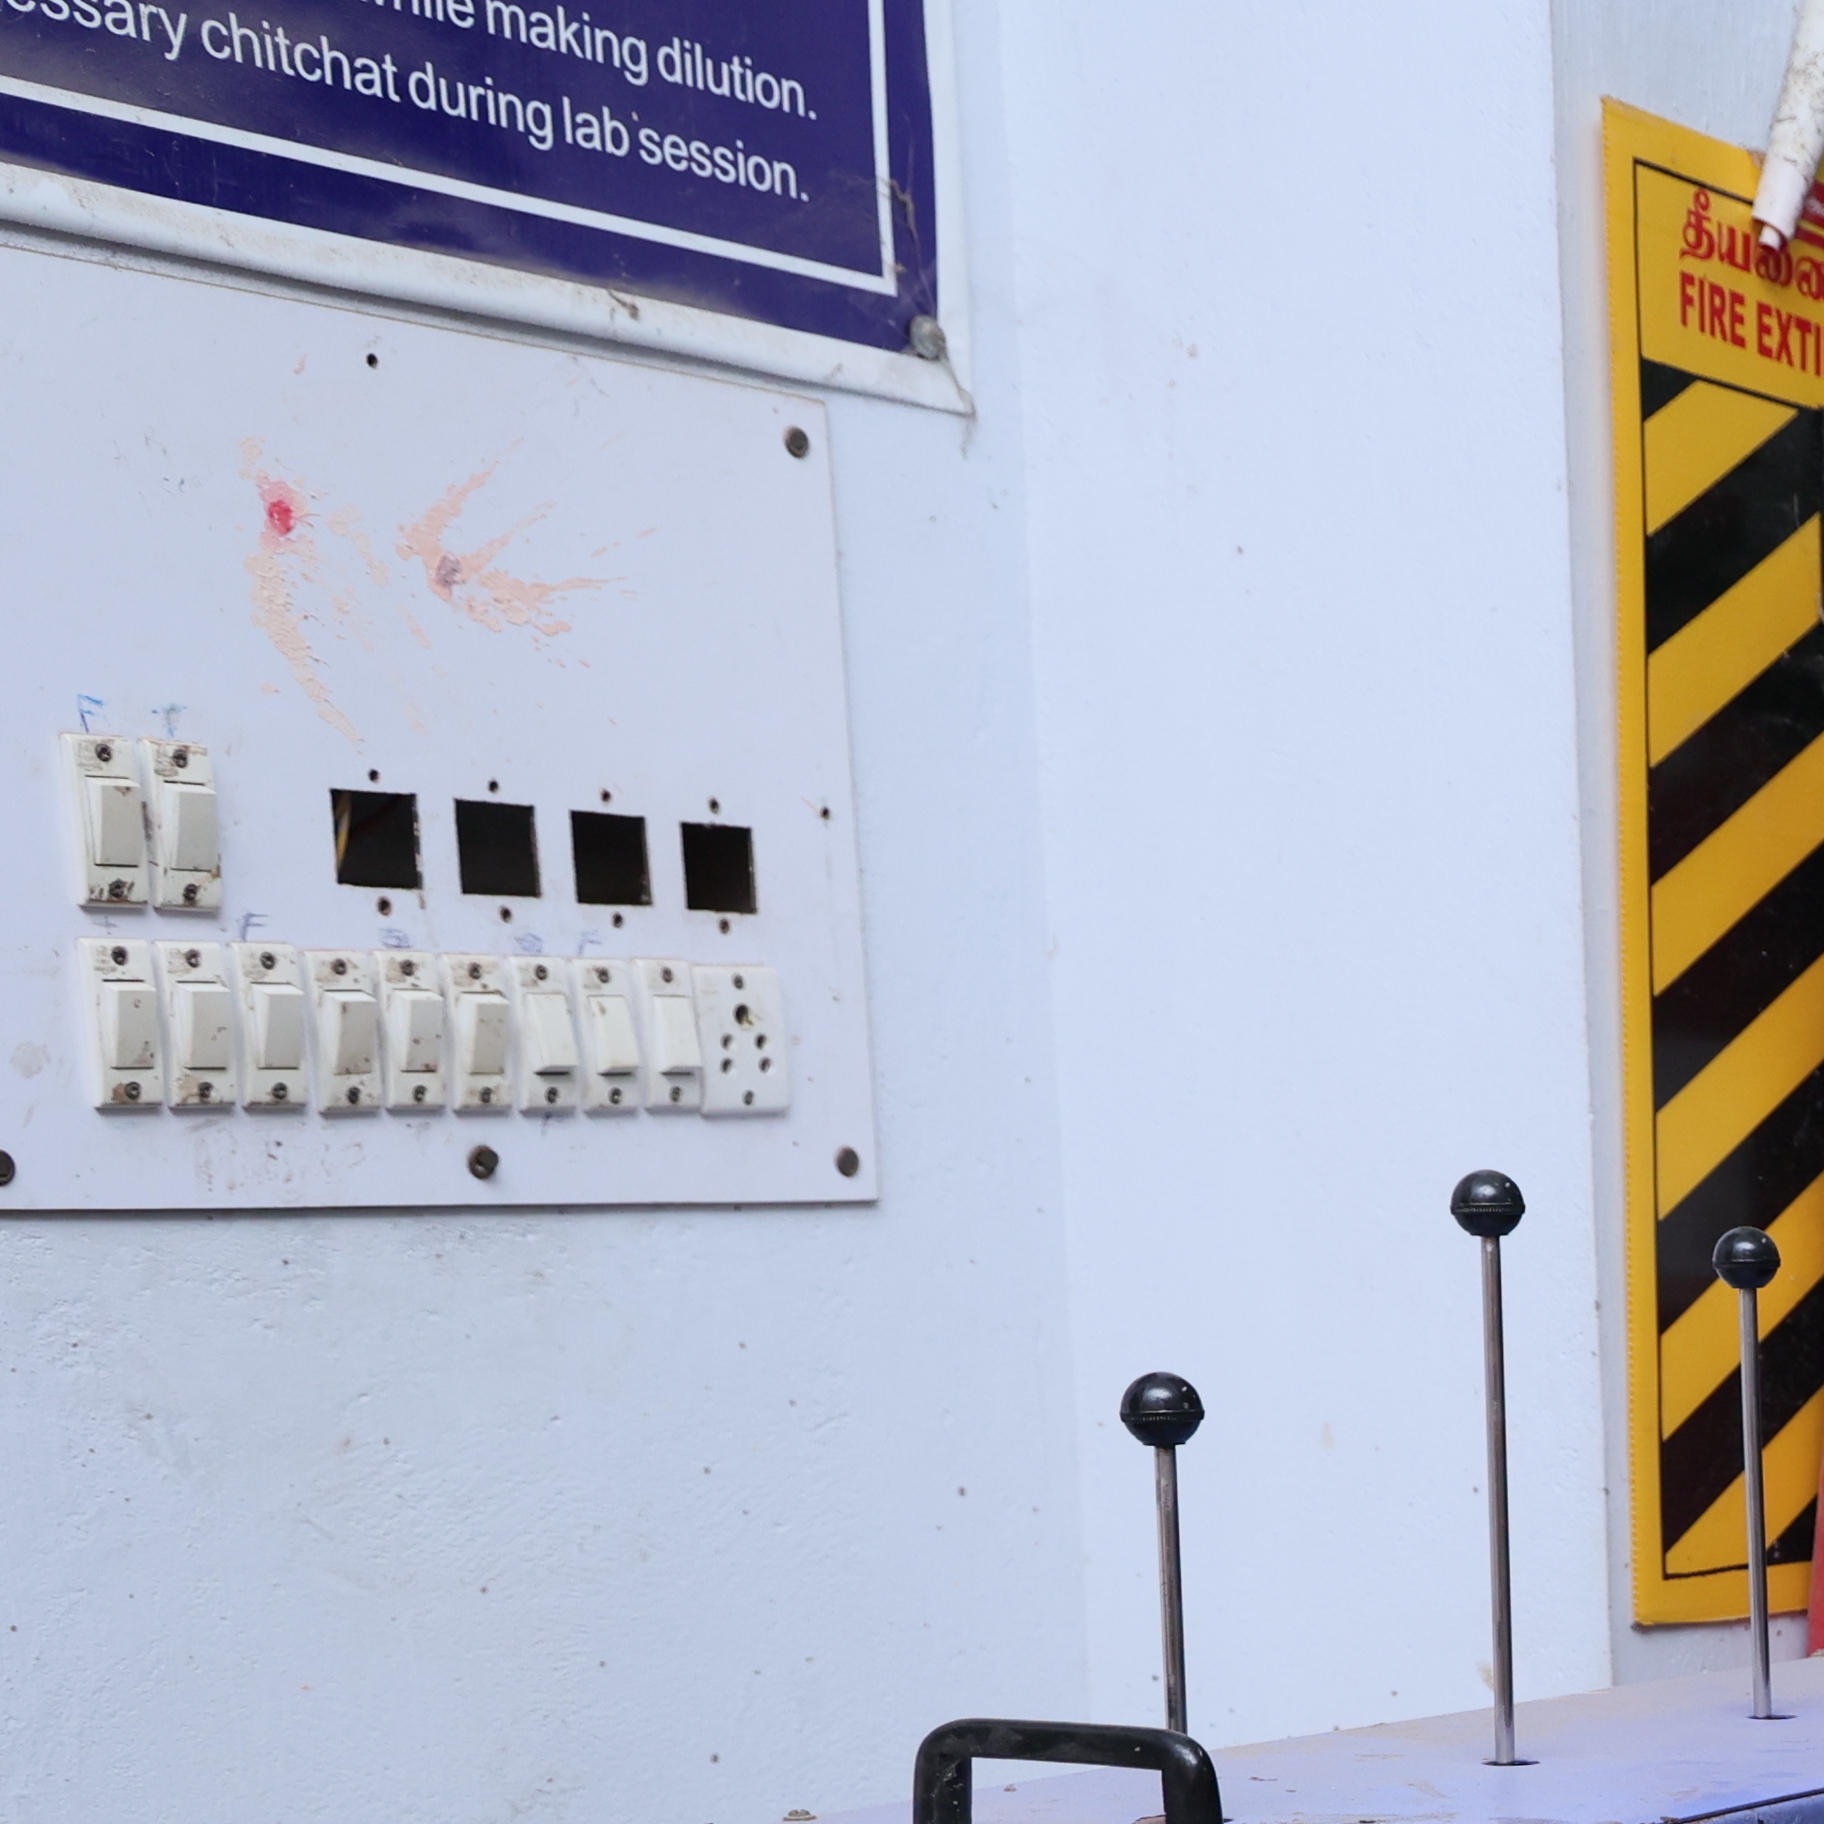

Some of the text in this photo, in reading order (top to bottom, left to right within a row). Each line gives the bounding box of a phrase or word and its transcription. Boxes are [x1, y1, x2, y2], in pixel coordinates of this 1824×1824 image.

[201, 12, 401, 102] chitchat
[408, 62, 554, 151] during
[562, 96, 630, 157] lab
[638, 125, 811, 202] session.
[484, 0, 818, 120] making dilution.
[1679, 270, 1747, 349] FIRE
